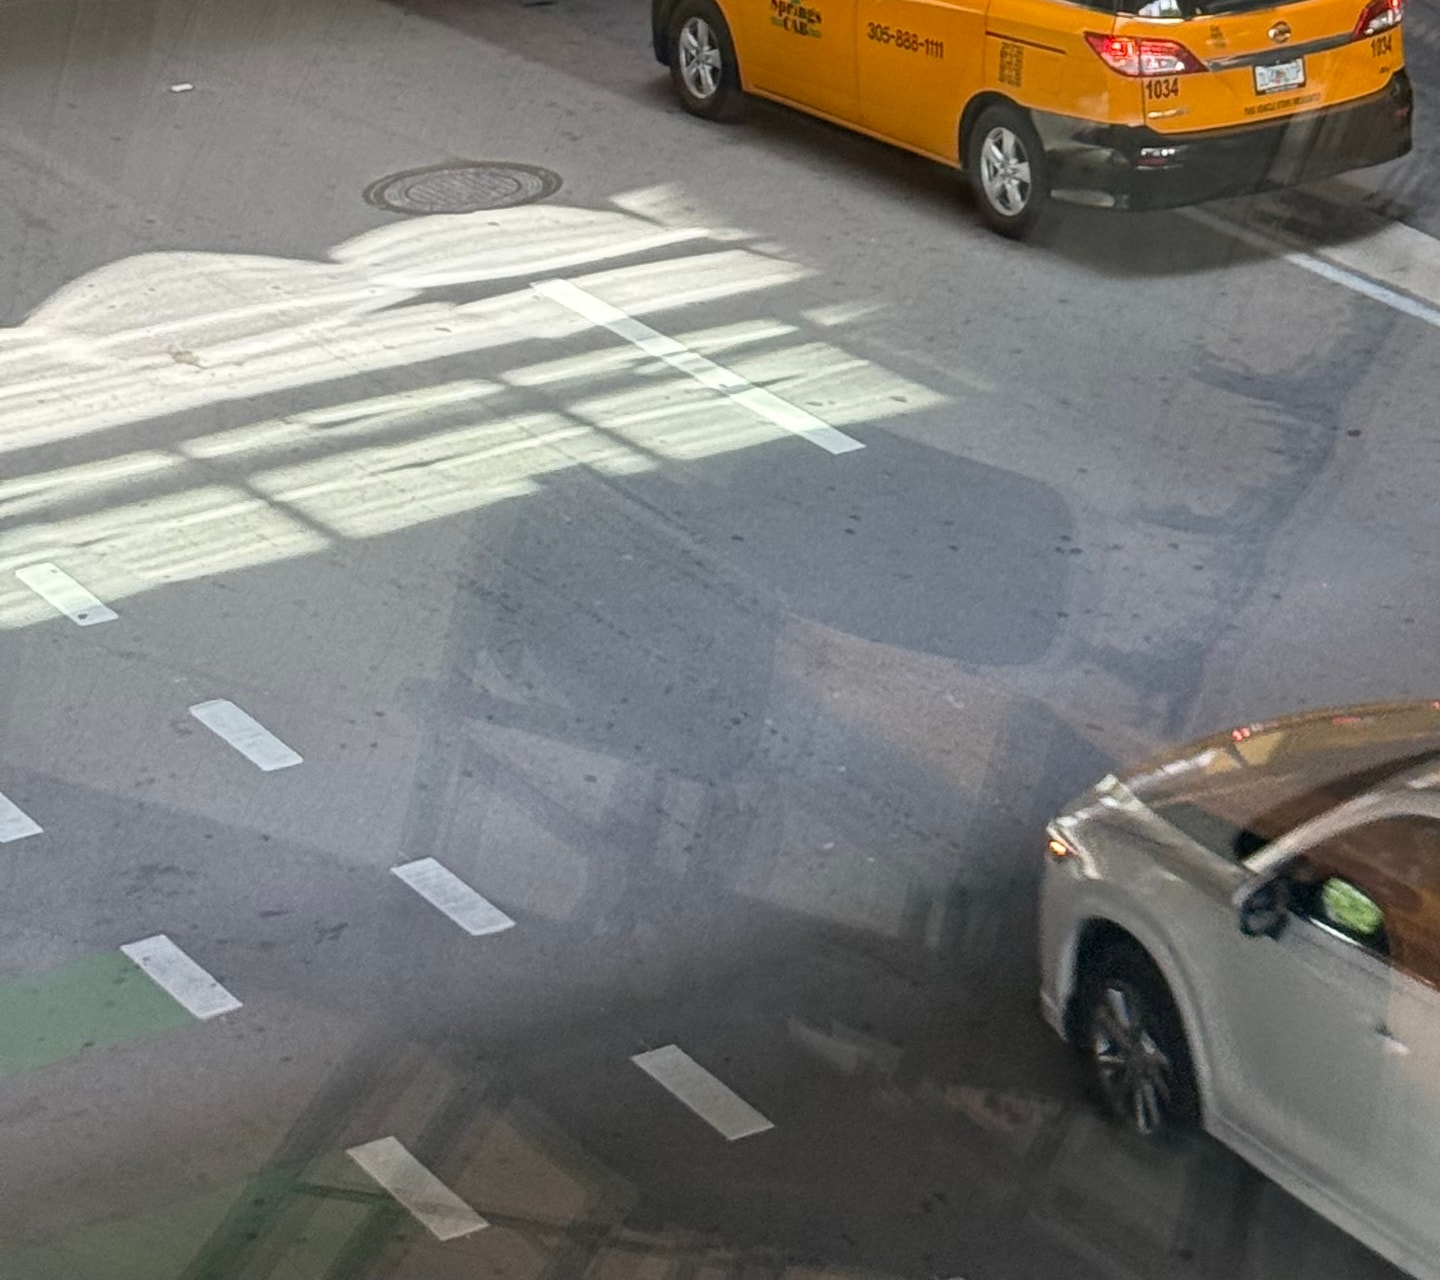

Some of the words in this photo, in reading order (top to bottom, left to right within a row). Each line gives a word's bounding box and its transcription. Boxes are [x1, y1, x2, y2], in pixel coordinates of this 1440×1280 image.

[783, 16, 809, 36] CAB
[867, 22, 944, 59] 305-888-1111
[1371, 34, 1392, 58] 1034
[1146, 77, 1179, 100] 1034
